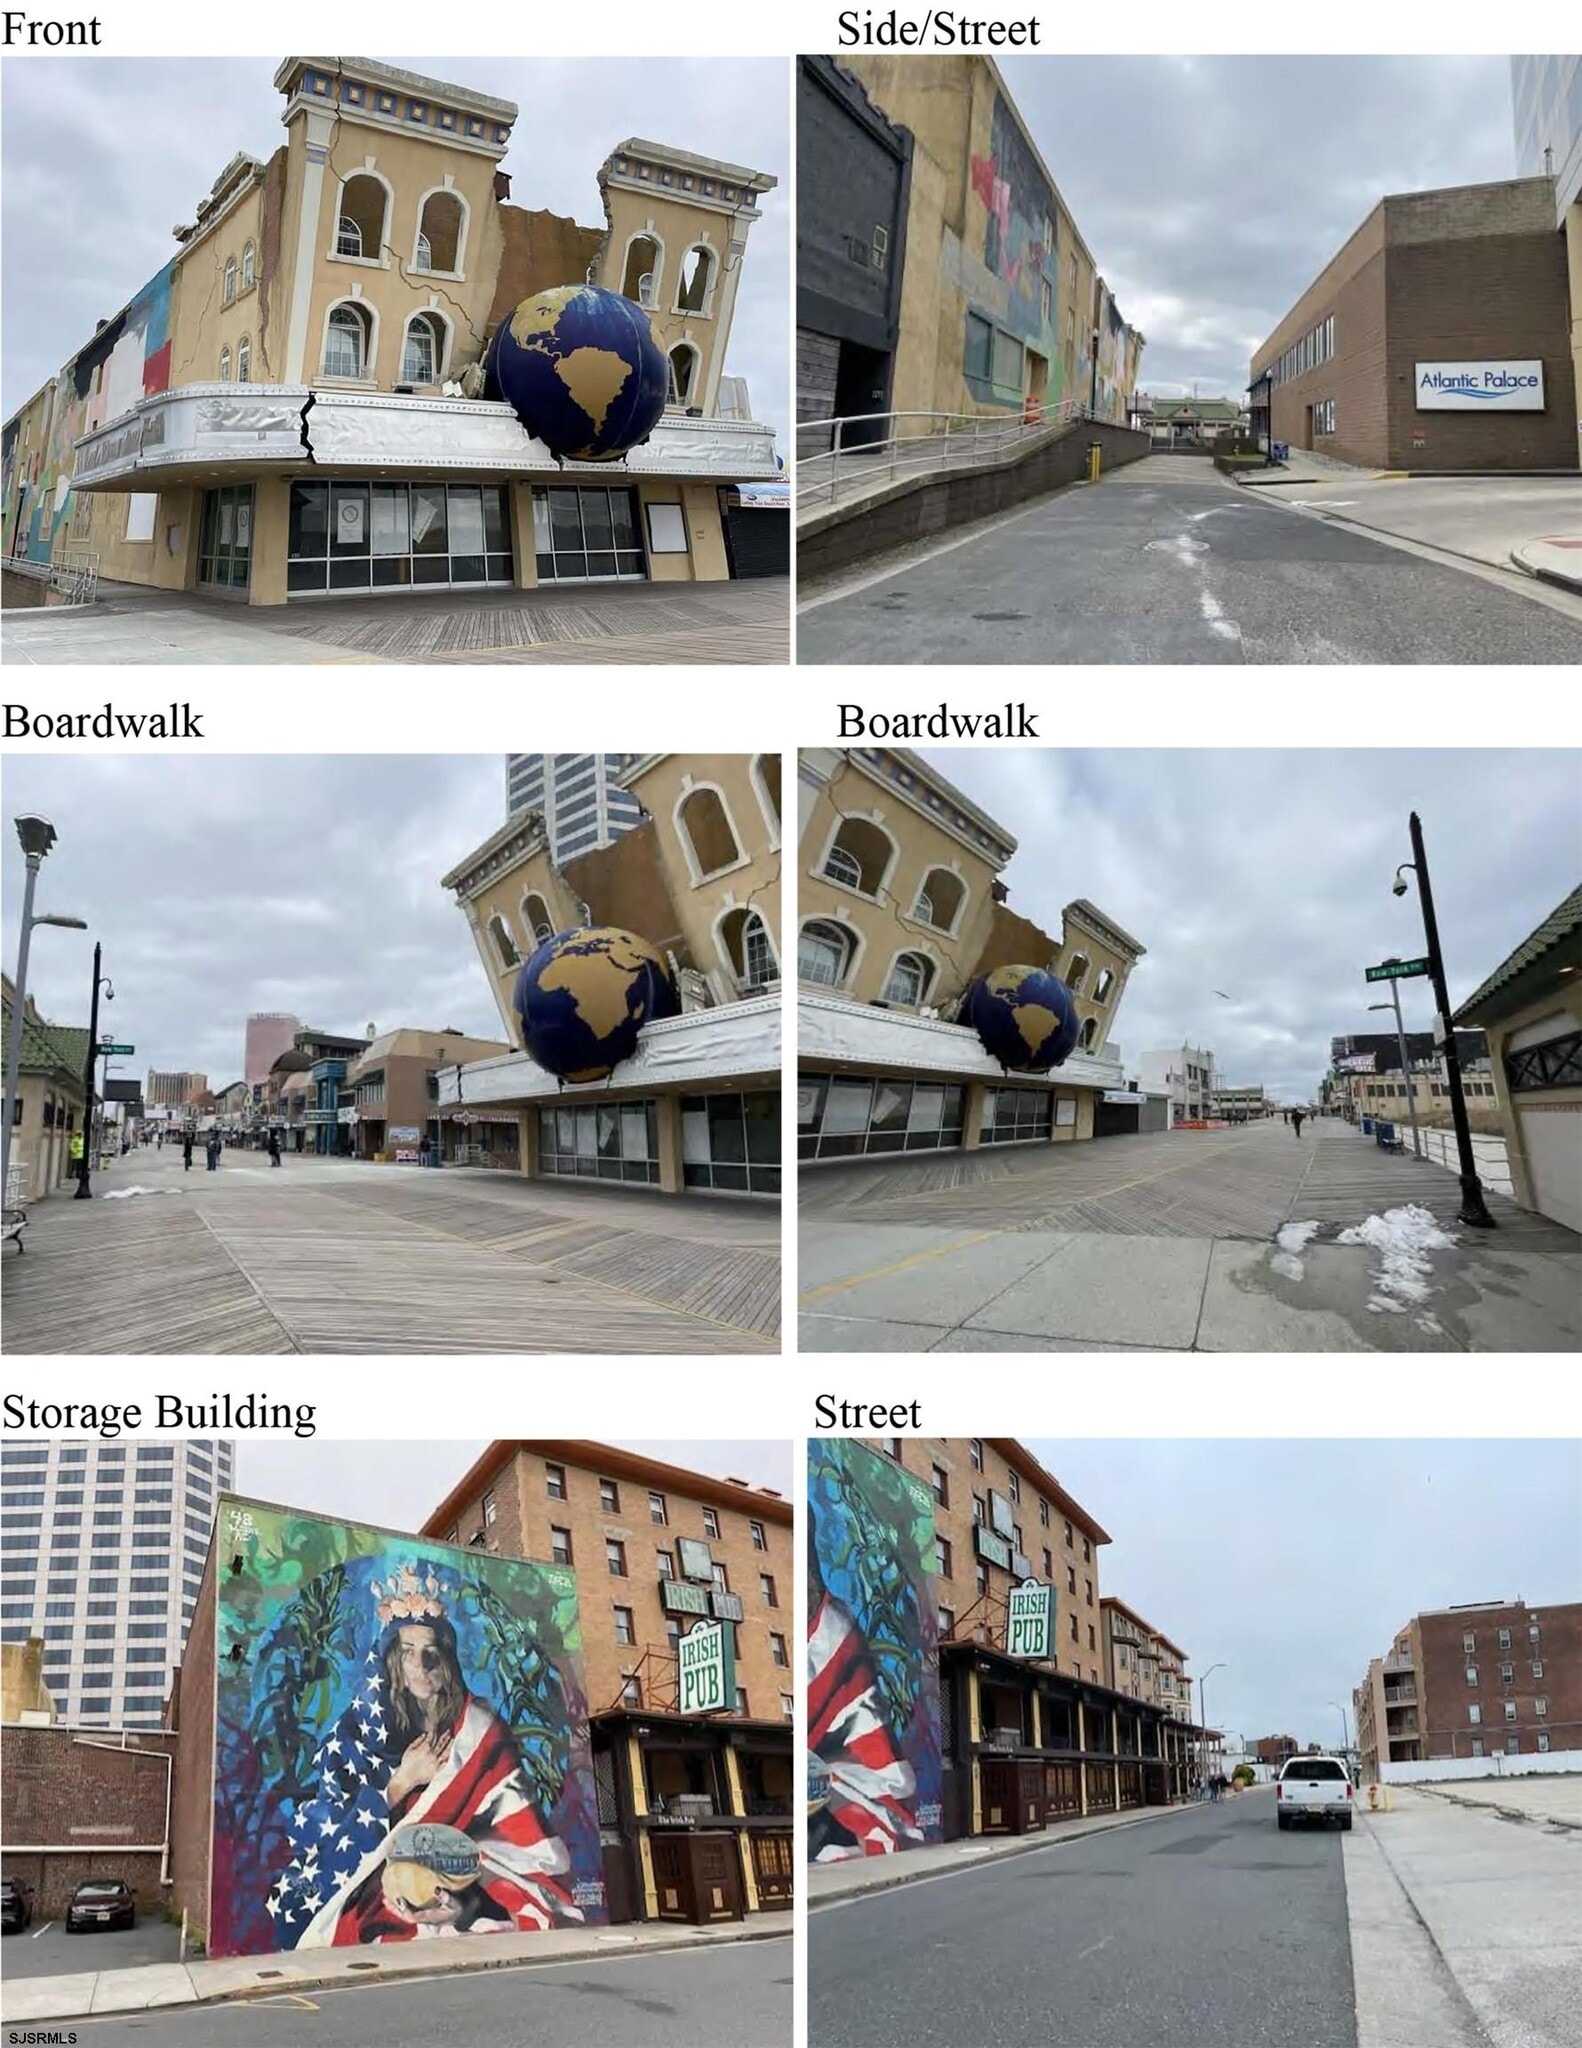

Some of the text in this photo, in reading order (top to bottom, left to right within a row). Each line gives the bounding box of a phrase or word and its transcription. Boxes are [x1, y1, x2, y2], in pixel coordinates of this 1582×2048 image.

[1420, 369, 1539, 388] Atlantic Palace
[1011, 1593, 1047, 1616] IRISH
[681, 1632, 719, 1668] IRISH
[1011, 1618, 1044, 1654] PUB
[684, 1663, 719, 1710] PUB
